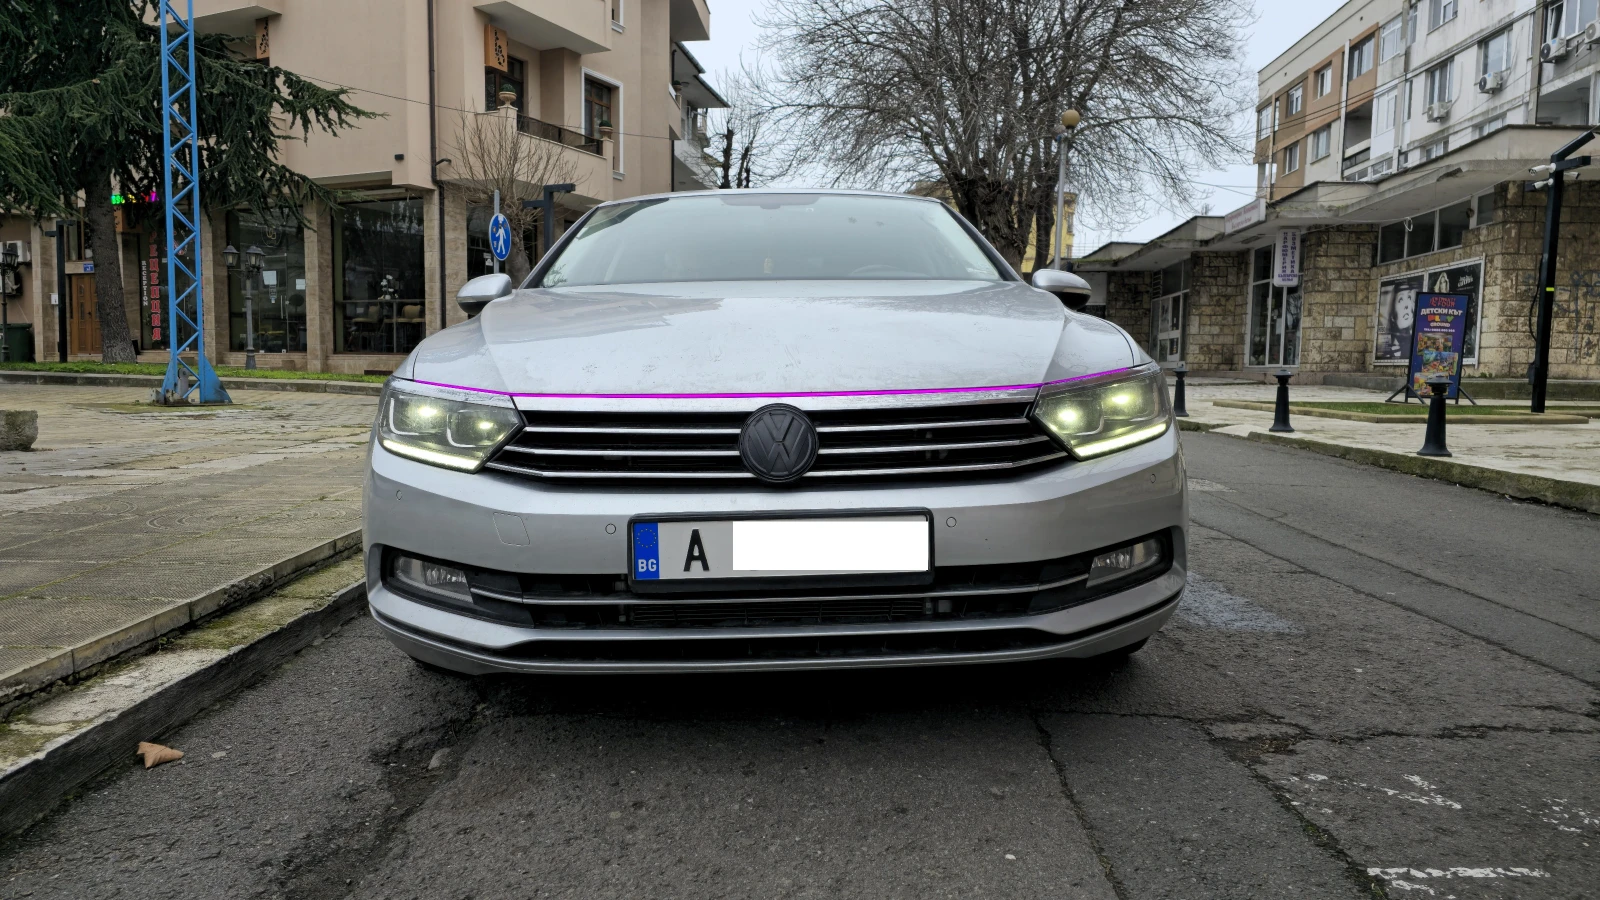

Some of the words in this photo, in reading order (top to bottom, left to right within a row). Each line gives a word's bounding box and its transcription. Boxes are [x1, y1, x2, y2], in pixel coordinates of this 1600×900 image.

[141, 260, 149, 306] RECEPTION
[149, 231, 161, 341] РЕЦЕПЦИЯ
[1420, 307, 1448, 316] ДЕТСКИ
[1448, 308, 1463, 317] КЪТ
[638, 559, 657, 573] BG
